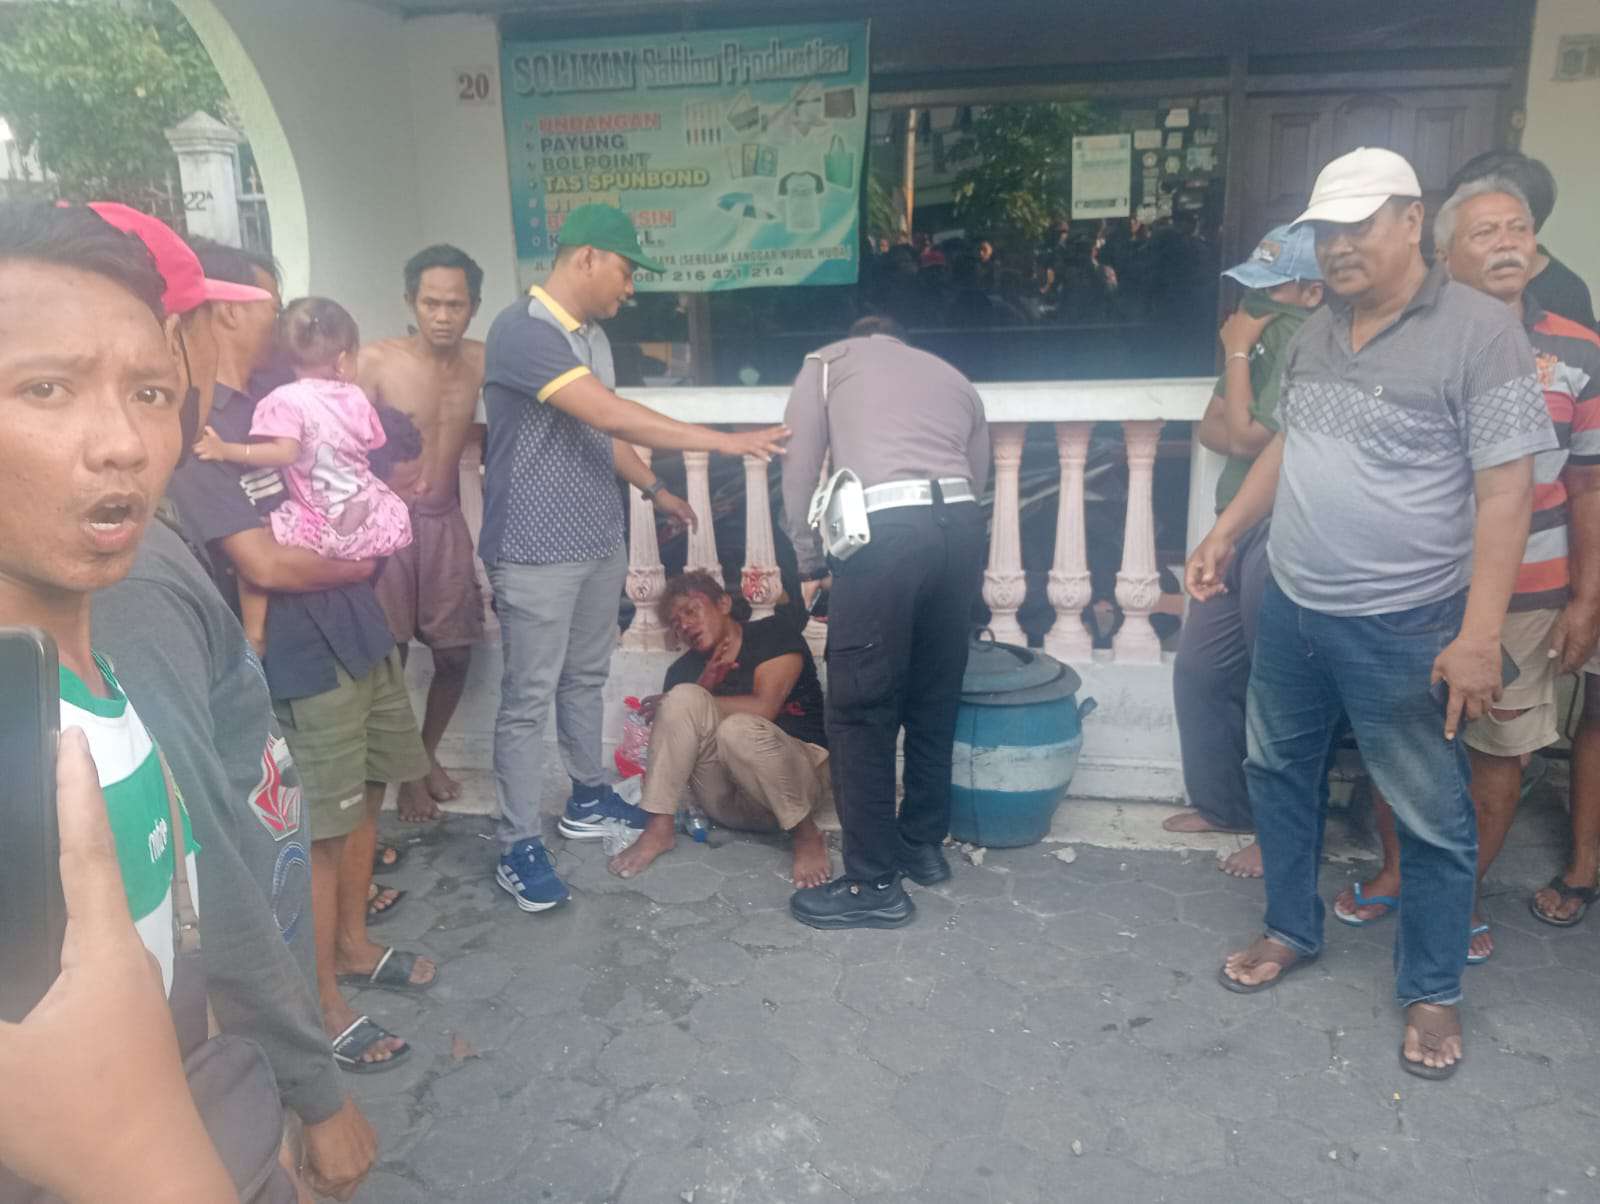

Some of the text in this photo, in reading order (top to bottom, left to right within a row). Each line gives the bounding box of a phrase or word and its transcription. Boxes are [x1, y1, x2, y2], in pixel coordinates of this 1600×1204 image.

[459, 72, 489, 100] 20
[541, 134, 626, 153] PAYUNG
[542, 153, 649, 172] BOLPOINT
[545, 169, 710, 193] TAS SPUNBOND
[672, 270, 706, 282] 216
[712, 268, 743, 280] 471
[751, 266, 785, 278] 214
